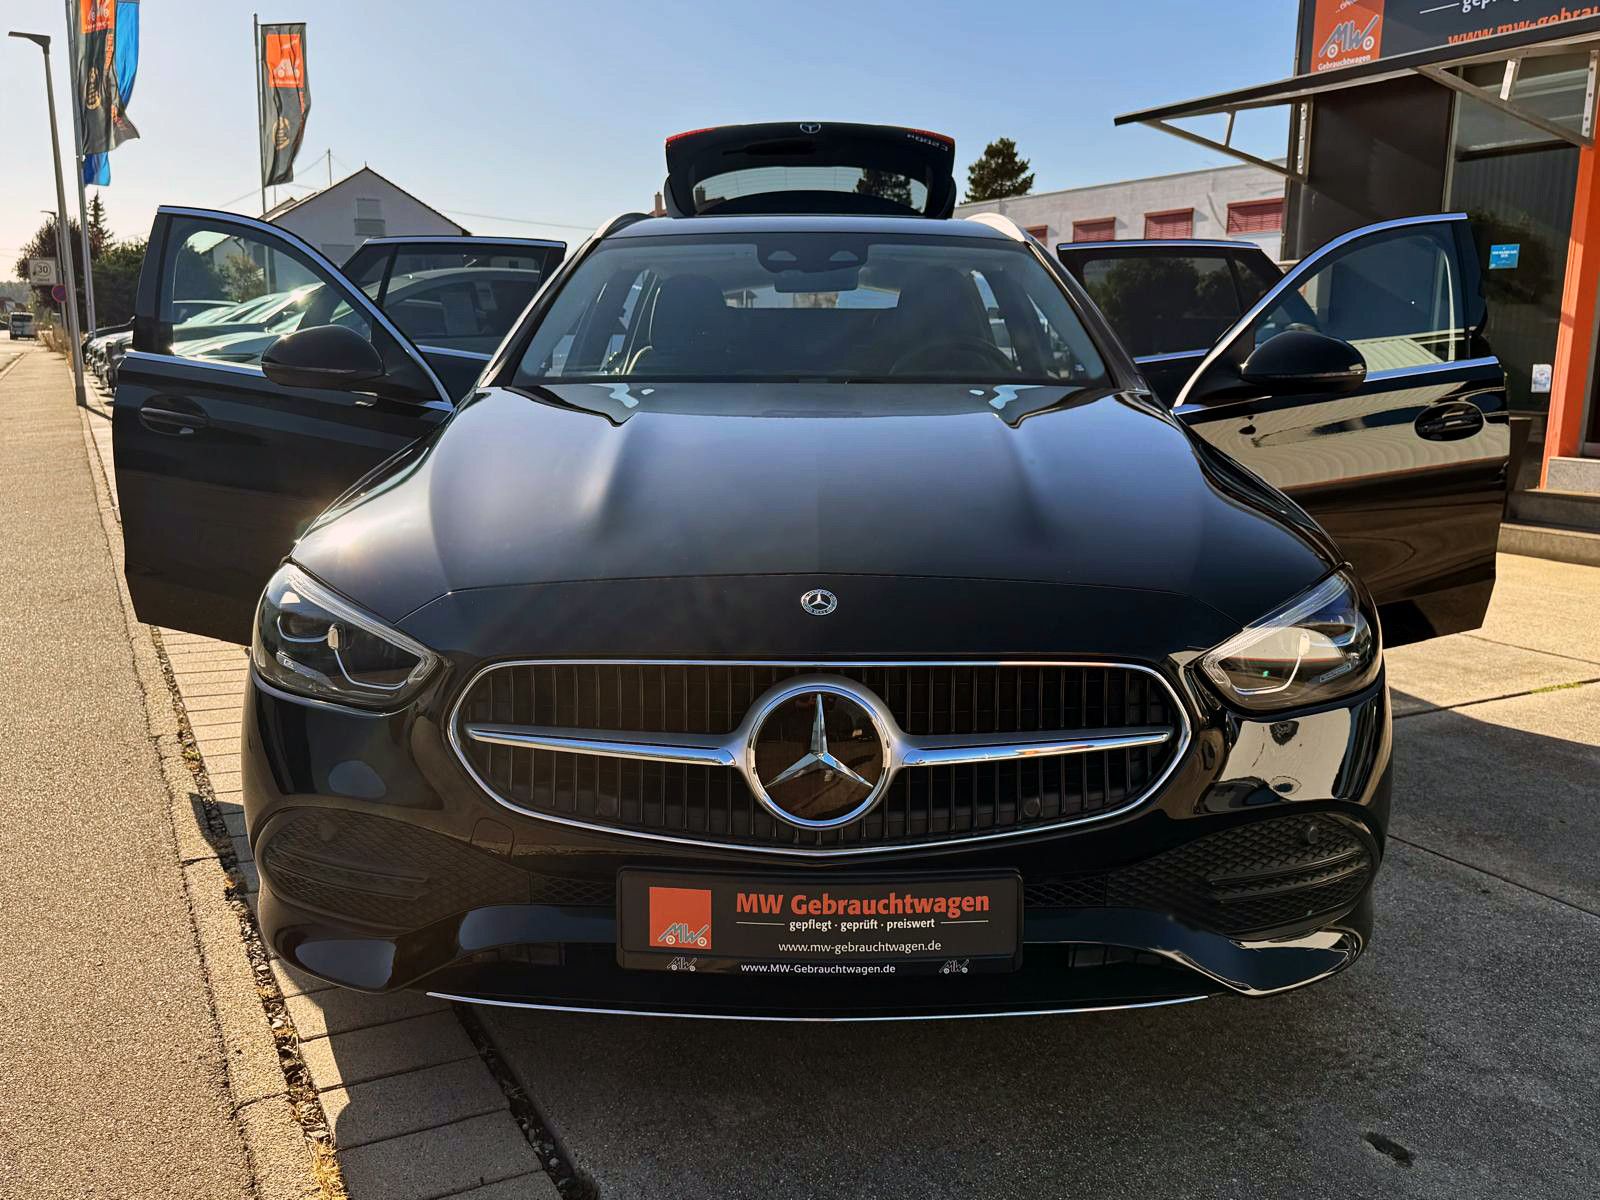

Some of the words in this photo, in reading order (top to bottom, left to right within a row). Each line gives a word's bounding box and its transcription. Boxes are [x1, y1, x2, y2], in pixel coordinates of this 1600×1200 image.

[38, 265, 49, 274] 30
[736, 893, 784, 914] MW
[790, 891, 989, 919] Gebrauchtwagen
[789, 919, 832, 932] gepflegt
[840, 918, 878, 932] geprüft
[887, 918, 935, 932] preiswert
[778, 940, 942, 954] www.mw-gebrauchtwagen.de
[740, 963, 896, 976] www.MW-Gebrauchtwagen.de
